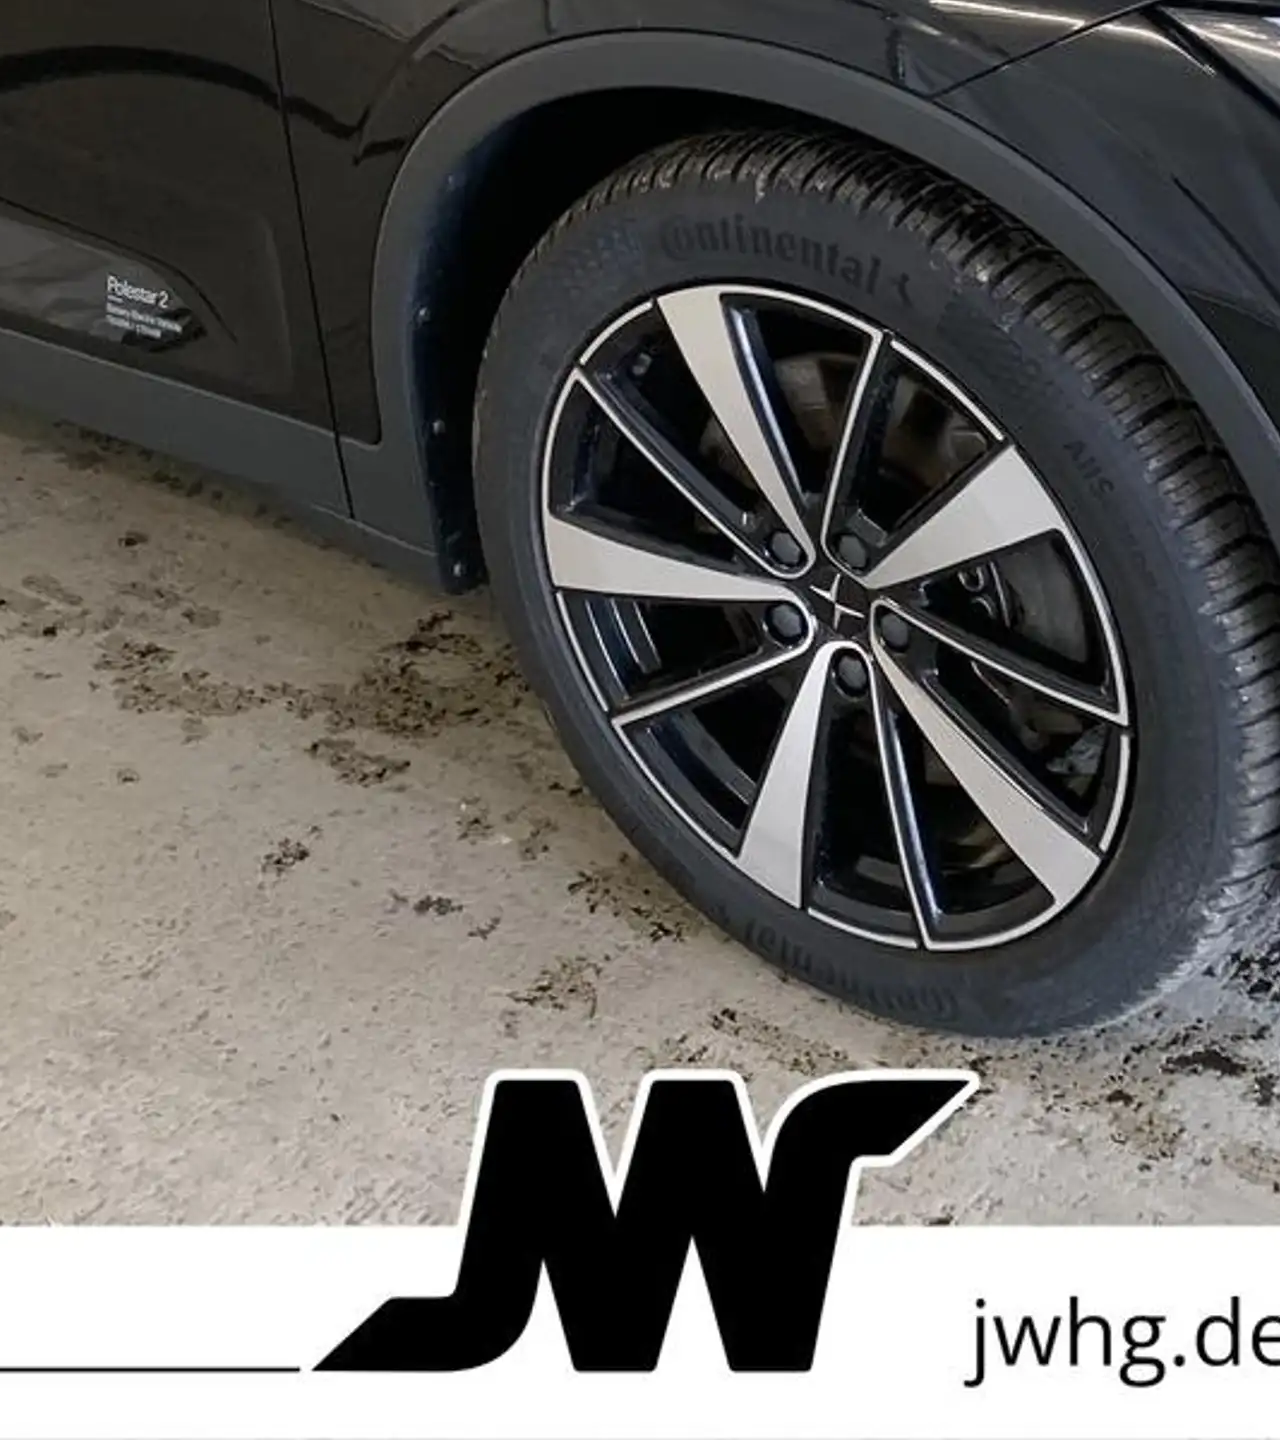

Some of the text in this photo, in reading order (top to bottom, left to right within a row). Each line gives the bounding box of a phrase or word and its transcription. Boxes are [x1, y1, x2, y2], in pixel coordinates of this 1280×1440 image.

[659, 212, 882, 296] Continental
[107, 276, 169, 309] Polestar 2
